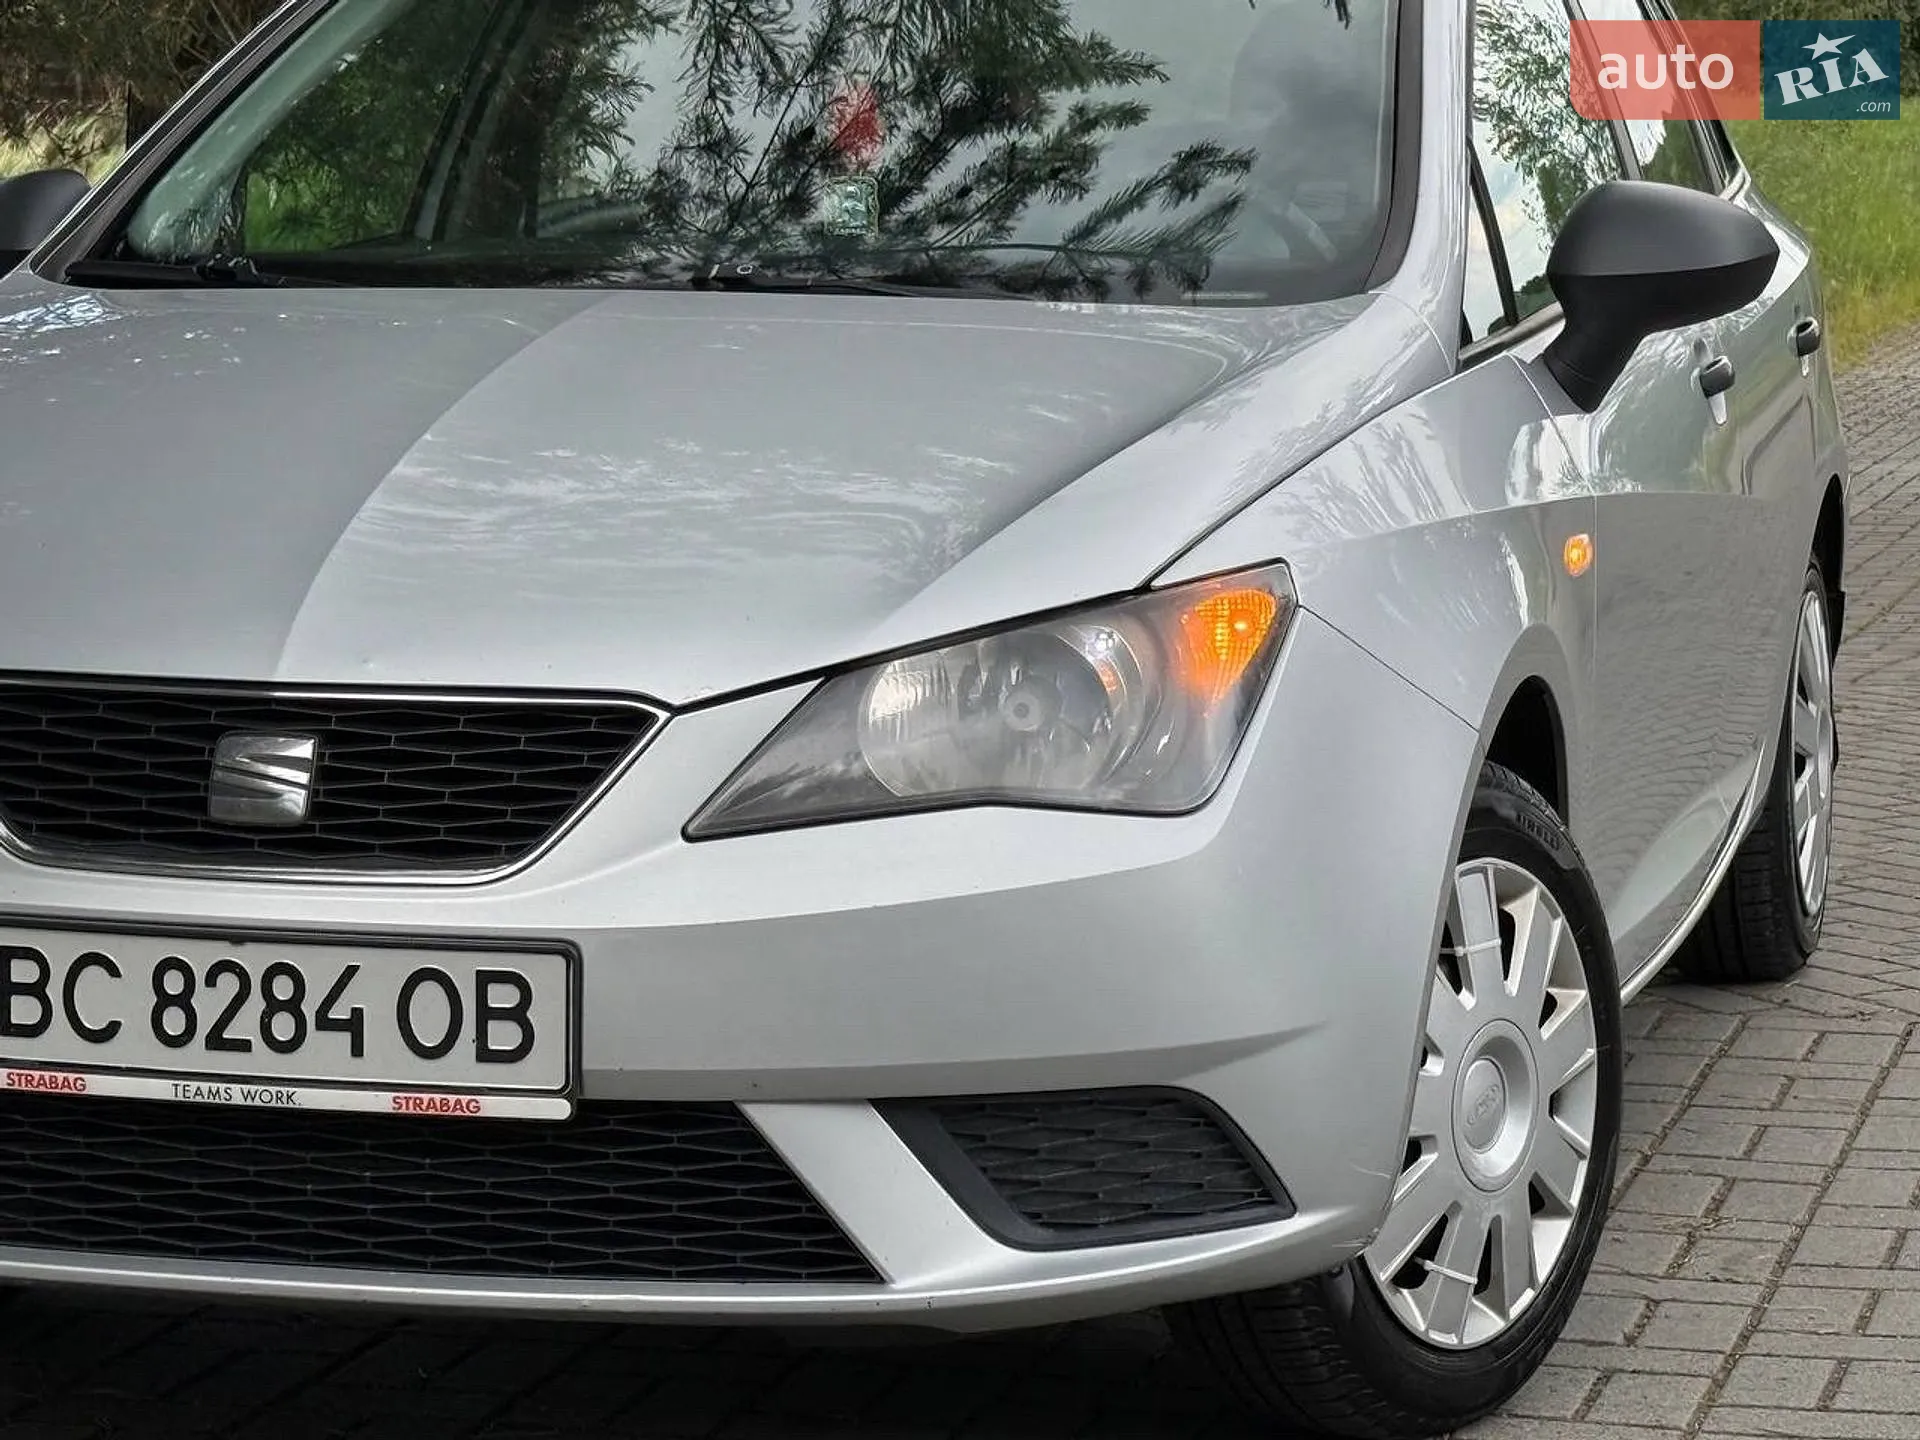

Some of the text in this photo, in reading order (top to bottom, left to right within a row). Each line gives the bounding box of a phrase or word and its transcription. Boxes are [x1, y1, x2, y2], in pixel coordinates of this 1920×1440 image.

[0, 946, 535, 1064] BC 8284 OB
[6, 1072, 481, 1114] STRABAG TEAMS WORK. STRABAG
